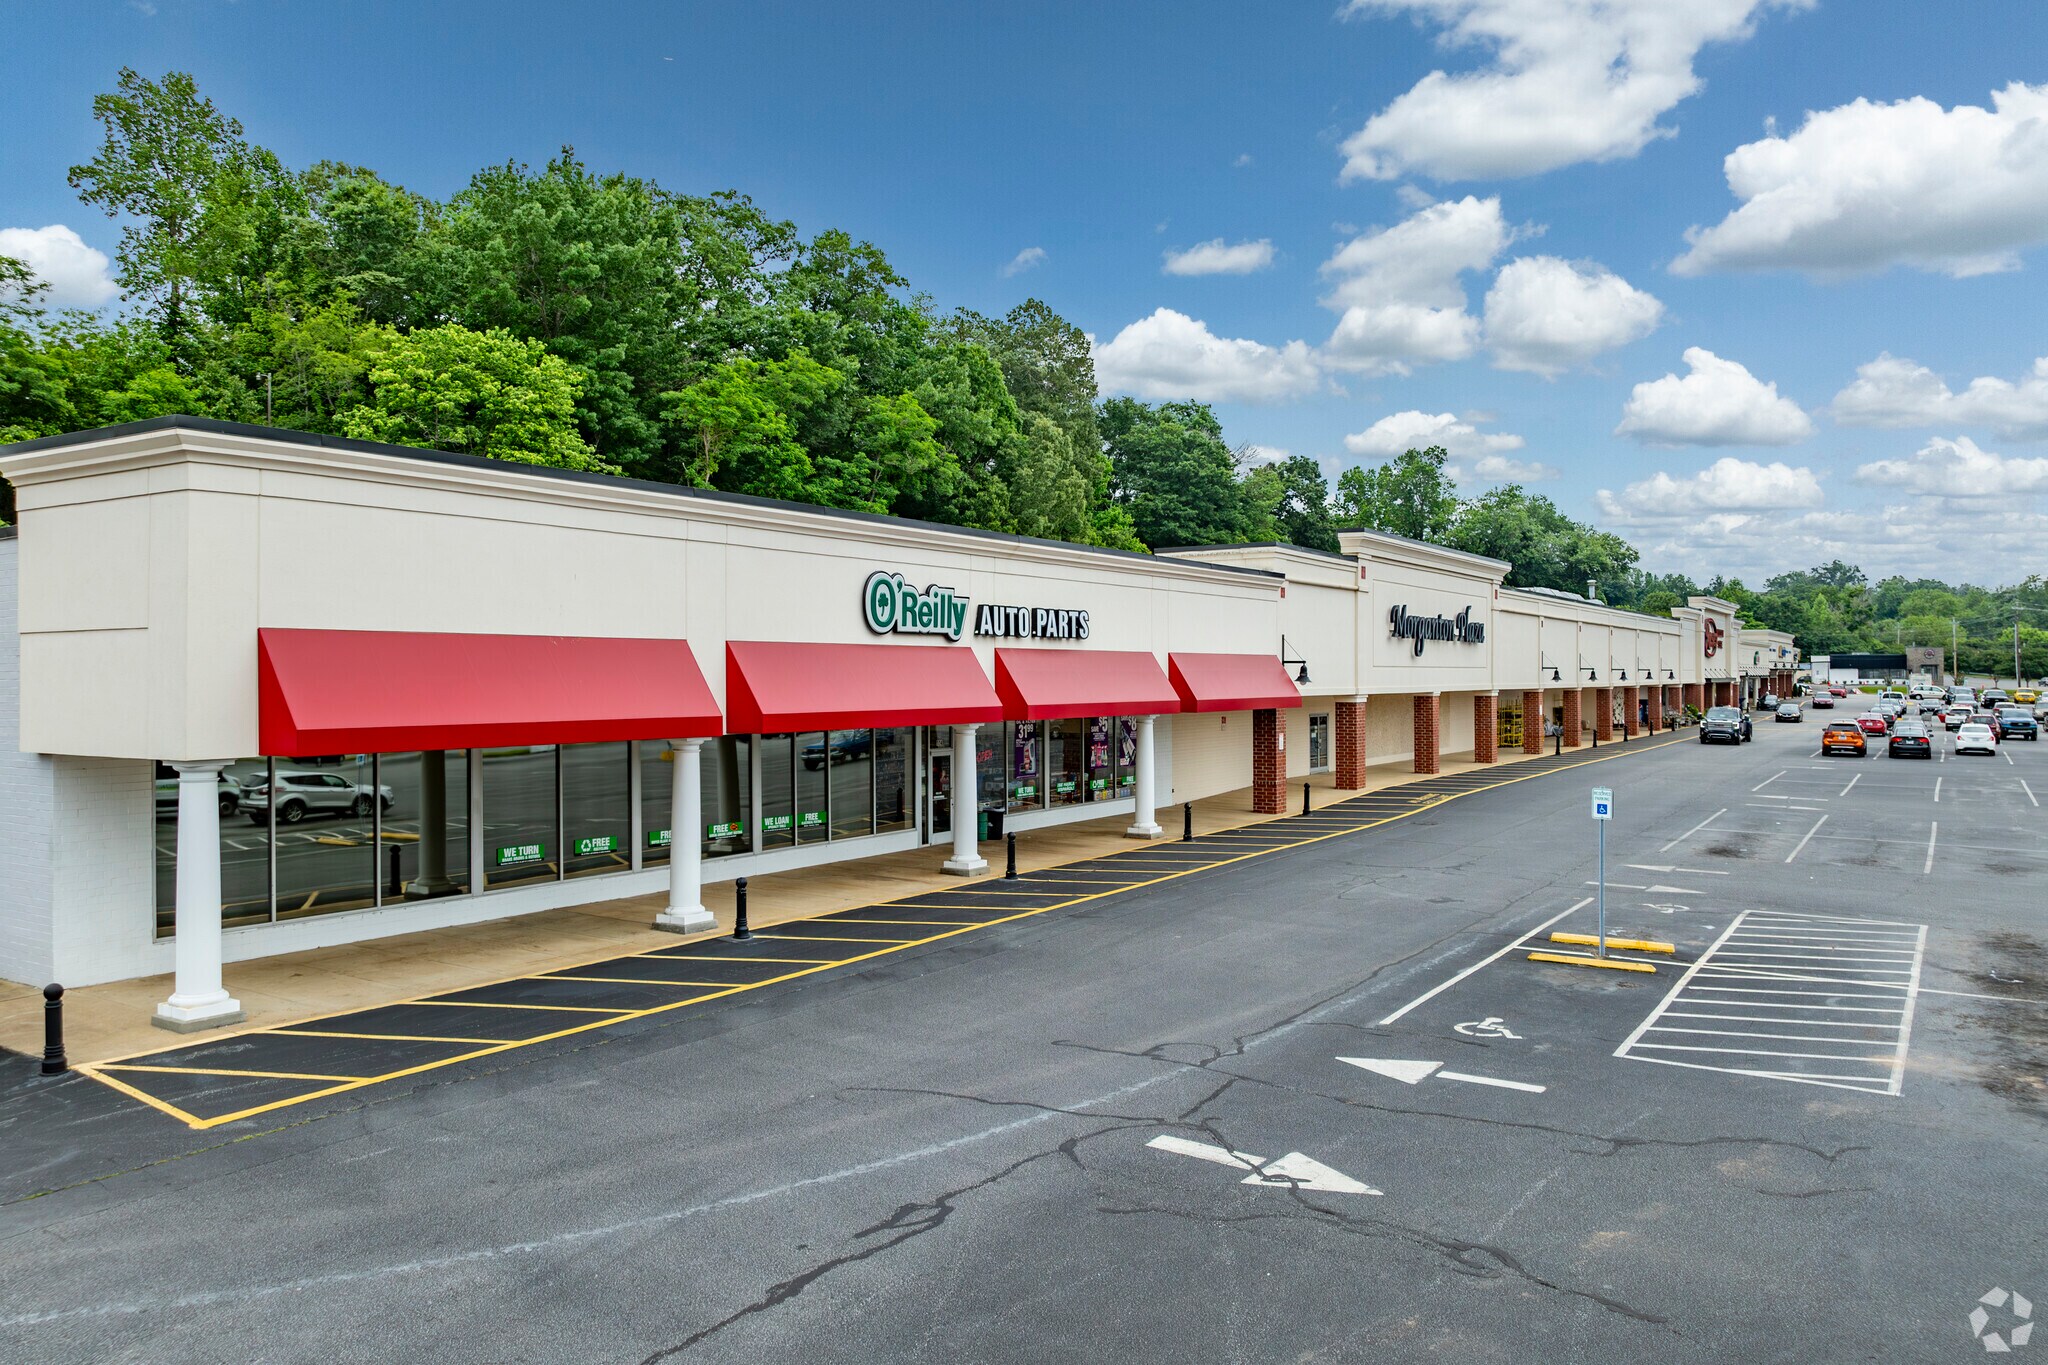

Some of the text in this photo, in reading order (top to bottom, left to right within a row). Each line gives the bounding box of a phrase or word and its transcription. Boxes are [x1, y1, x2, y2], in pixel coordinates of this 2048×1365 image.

[867, 573, 1089, 640] O'Reilly AUTO PARTS
[1389, 605, 1485, 657] Morganton Plaza
[764, 816, 790, 826] WE LOAN
[805, 813, 818, 821] FREE
[713, 824, 728, 833] FREE
[592, 837, 610, 847] FREE
[503, 844, 539, 858] WE TURN
